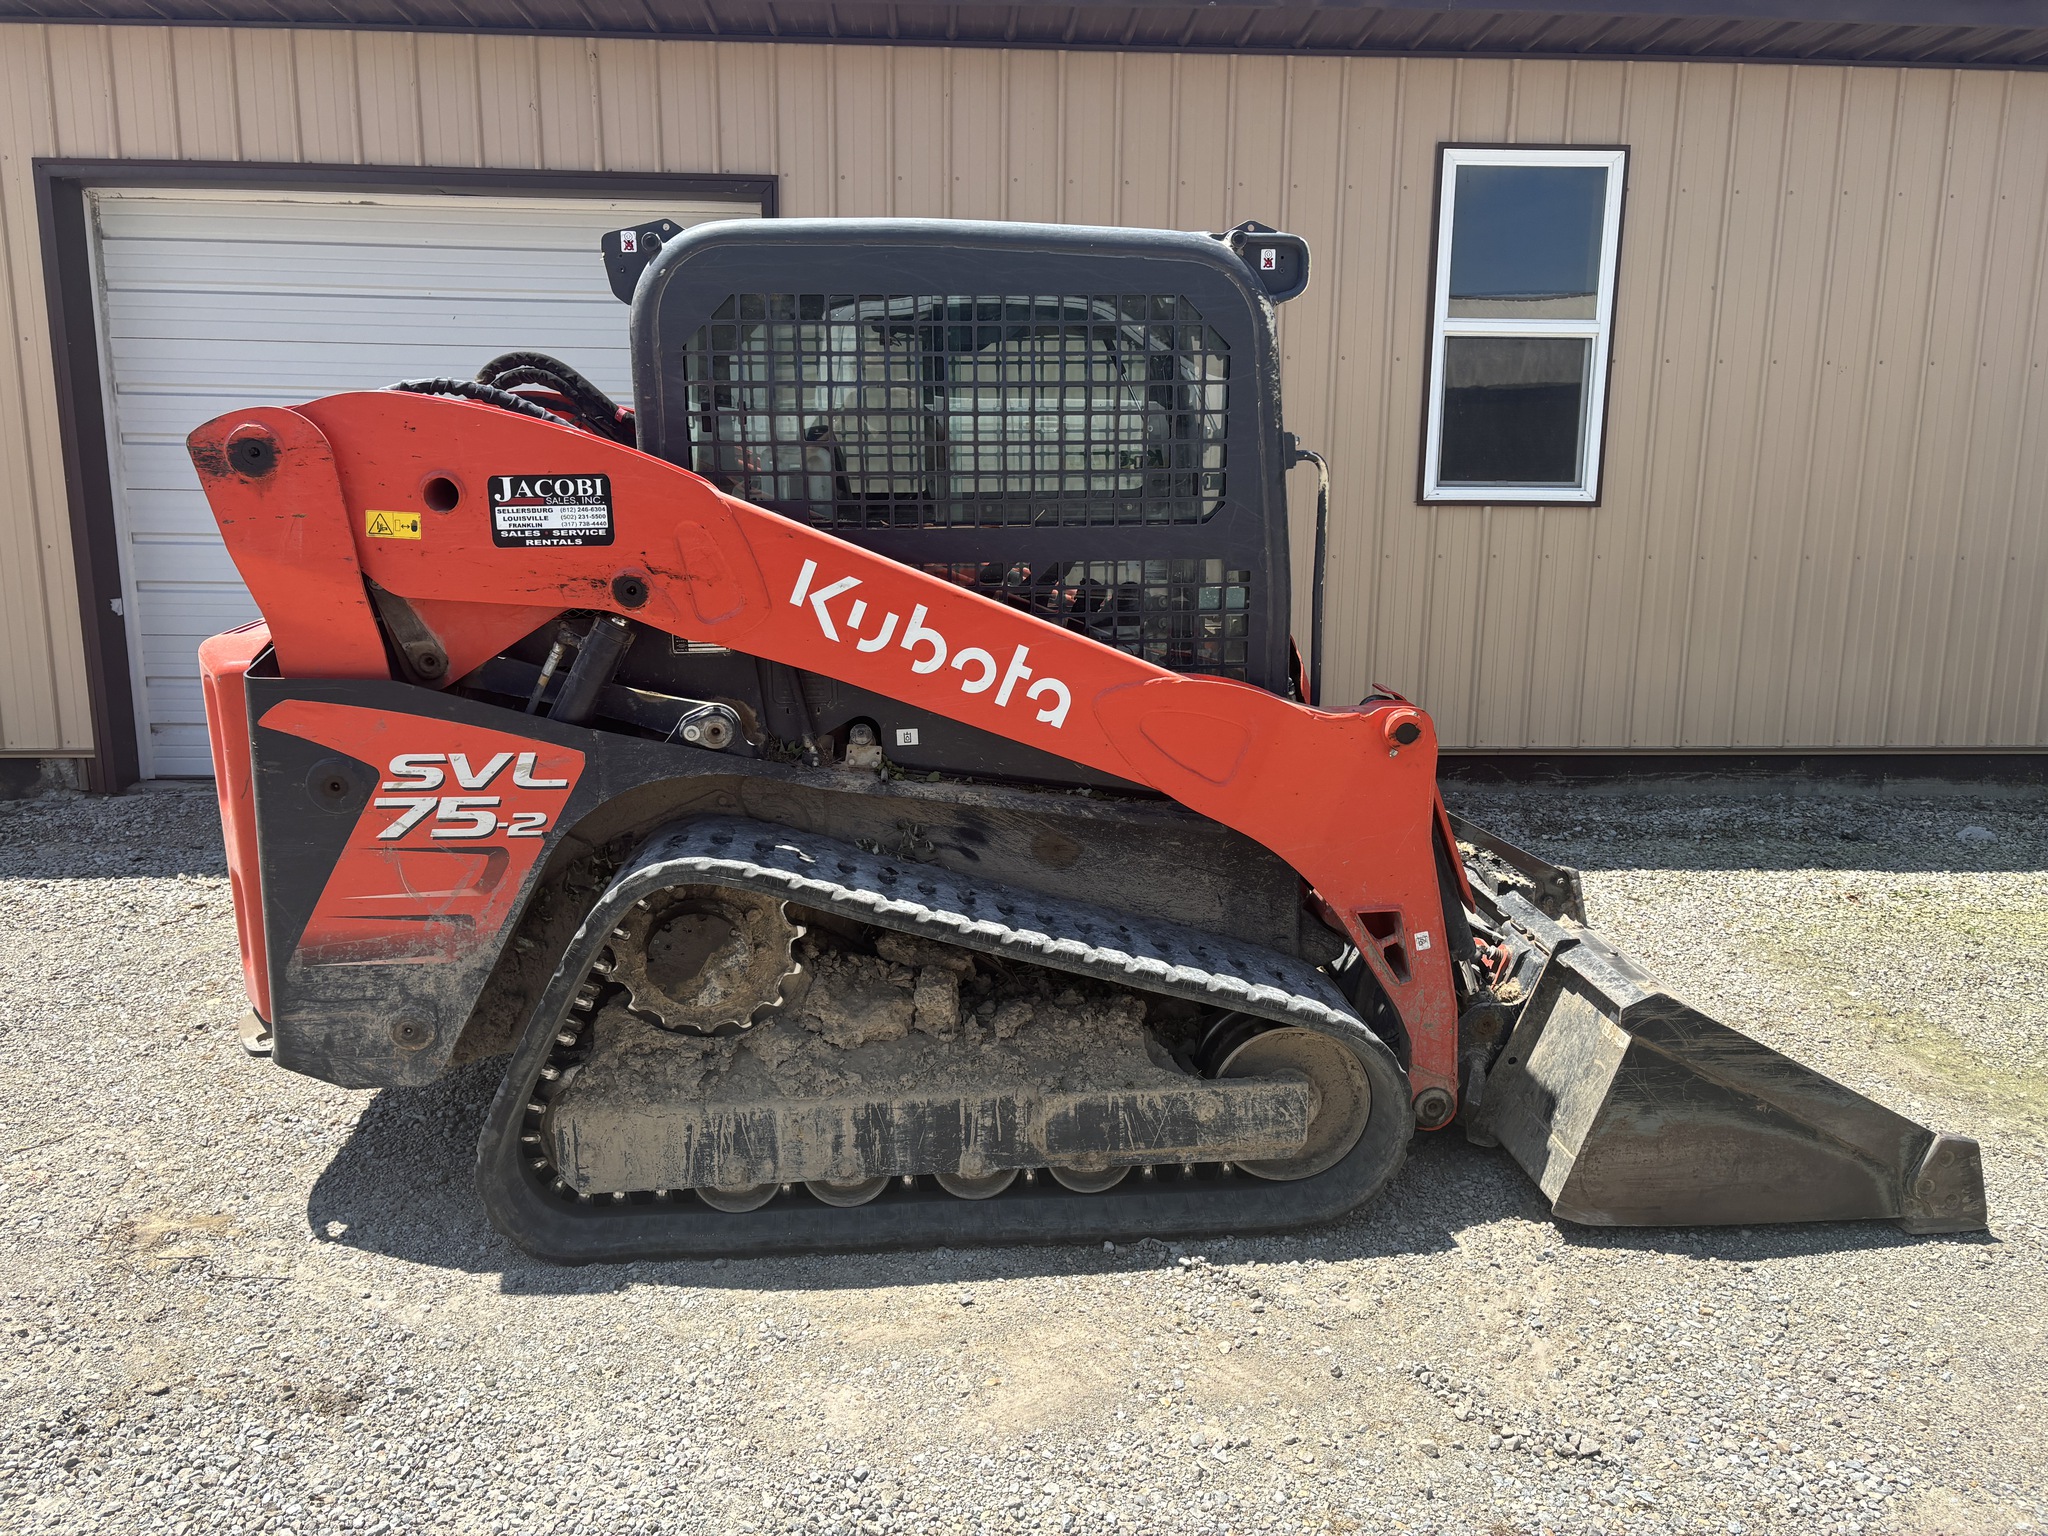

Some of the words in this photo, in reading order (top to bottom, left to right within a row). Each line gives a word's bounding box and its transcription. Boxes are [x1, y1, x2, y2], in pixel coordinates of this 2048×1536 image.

[494, 476, 604, 502] JACOBI
[545, 497, 579, 505] SALES,
[581, 496, 606, 504] INC.
[500, 530, 541, 538] SALES
[552, 528, 607, 537] SERVICE
[525, 538, 583, 547] RENTALS
[789, 558, 1072, 729] Kubota
[381, 752, 570, 791] SVL
[373, 795, 549, 841] 75-2
